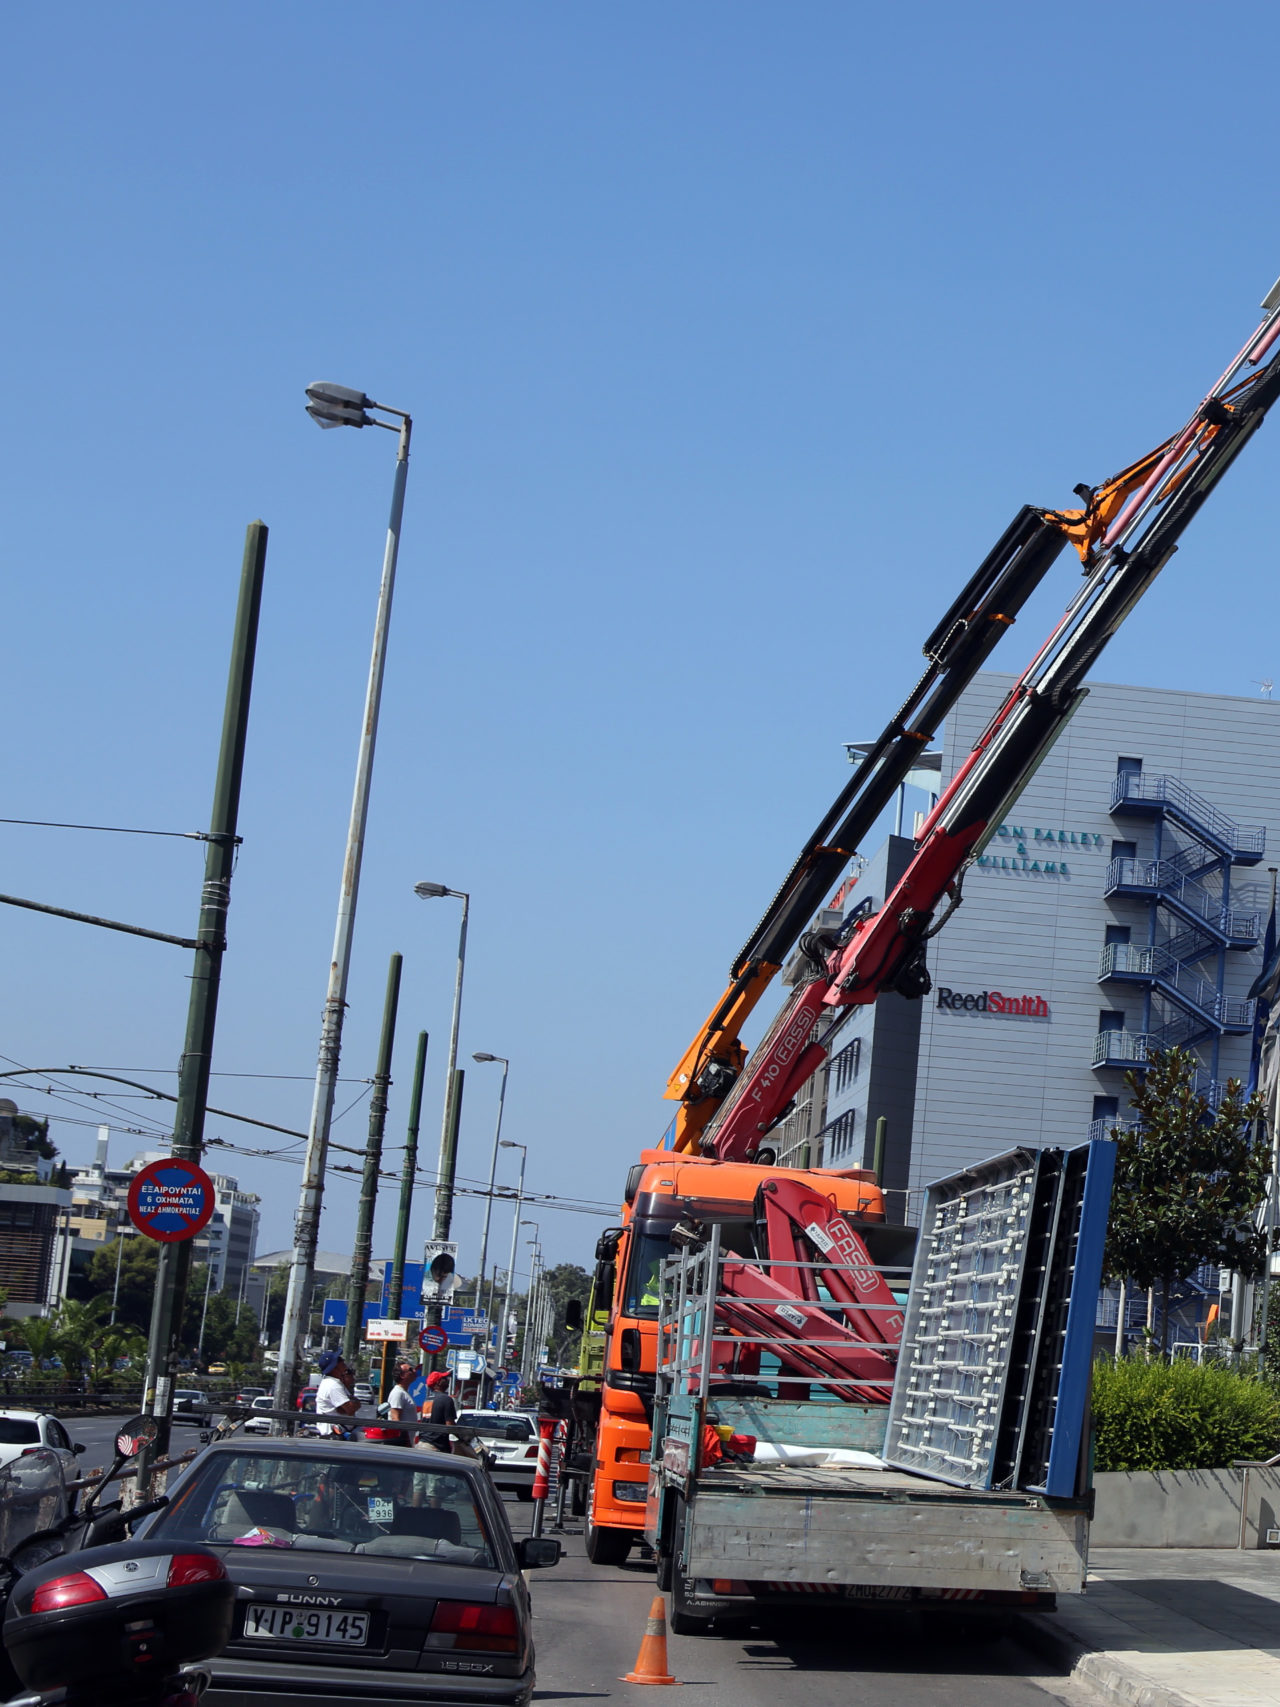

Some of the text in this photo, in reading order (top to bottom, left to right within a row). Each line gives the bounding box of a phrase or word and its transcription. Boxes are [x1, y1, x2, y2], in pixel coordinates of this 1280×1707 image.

[997, 824, 1100, 845] ON FARLEY
[1016, 842, 1026, 855] &
[977, 855, 1067, 875] WILLIAMS
[761, 1063, 780, 1089] 410
[776, 1009, 815, 1062] FASSI
[141, 1185, 201, 1196] ΕΞΑΙΡΟΥΝΤΑΙ
[146, 1195, 194, 1205] 6 ΟΧΗΜΑΤΑ
[139, 1205, 200, 1215] ΝΕΑΣ ΔΗΜΟΚΡΑΤΙΑΣ
[830, 1223, 875, 1288] FASSI
[375, 1509, 393, 1518] 936
[276, 1593, 342, 1606] SUNNY
